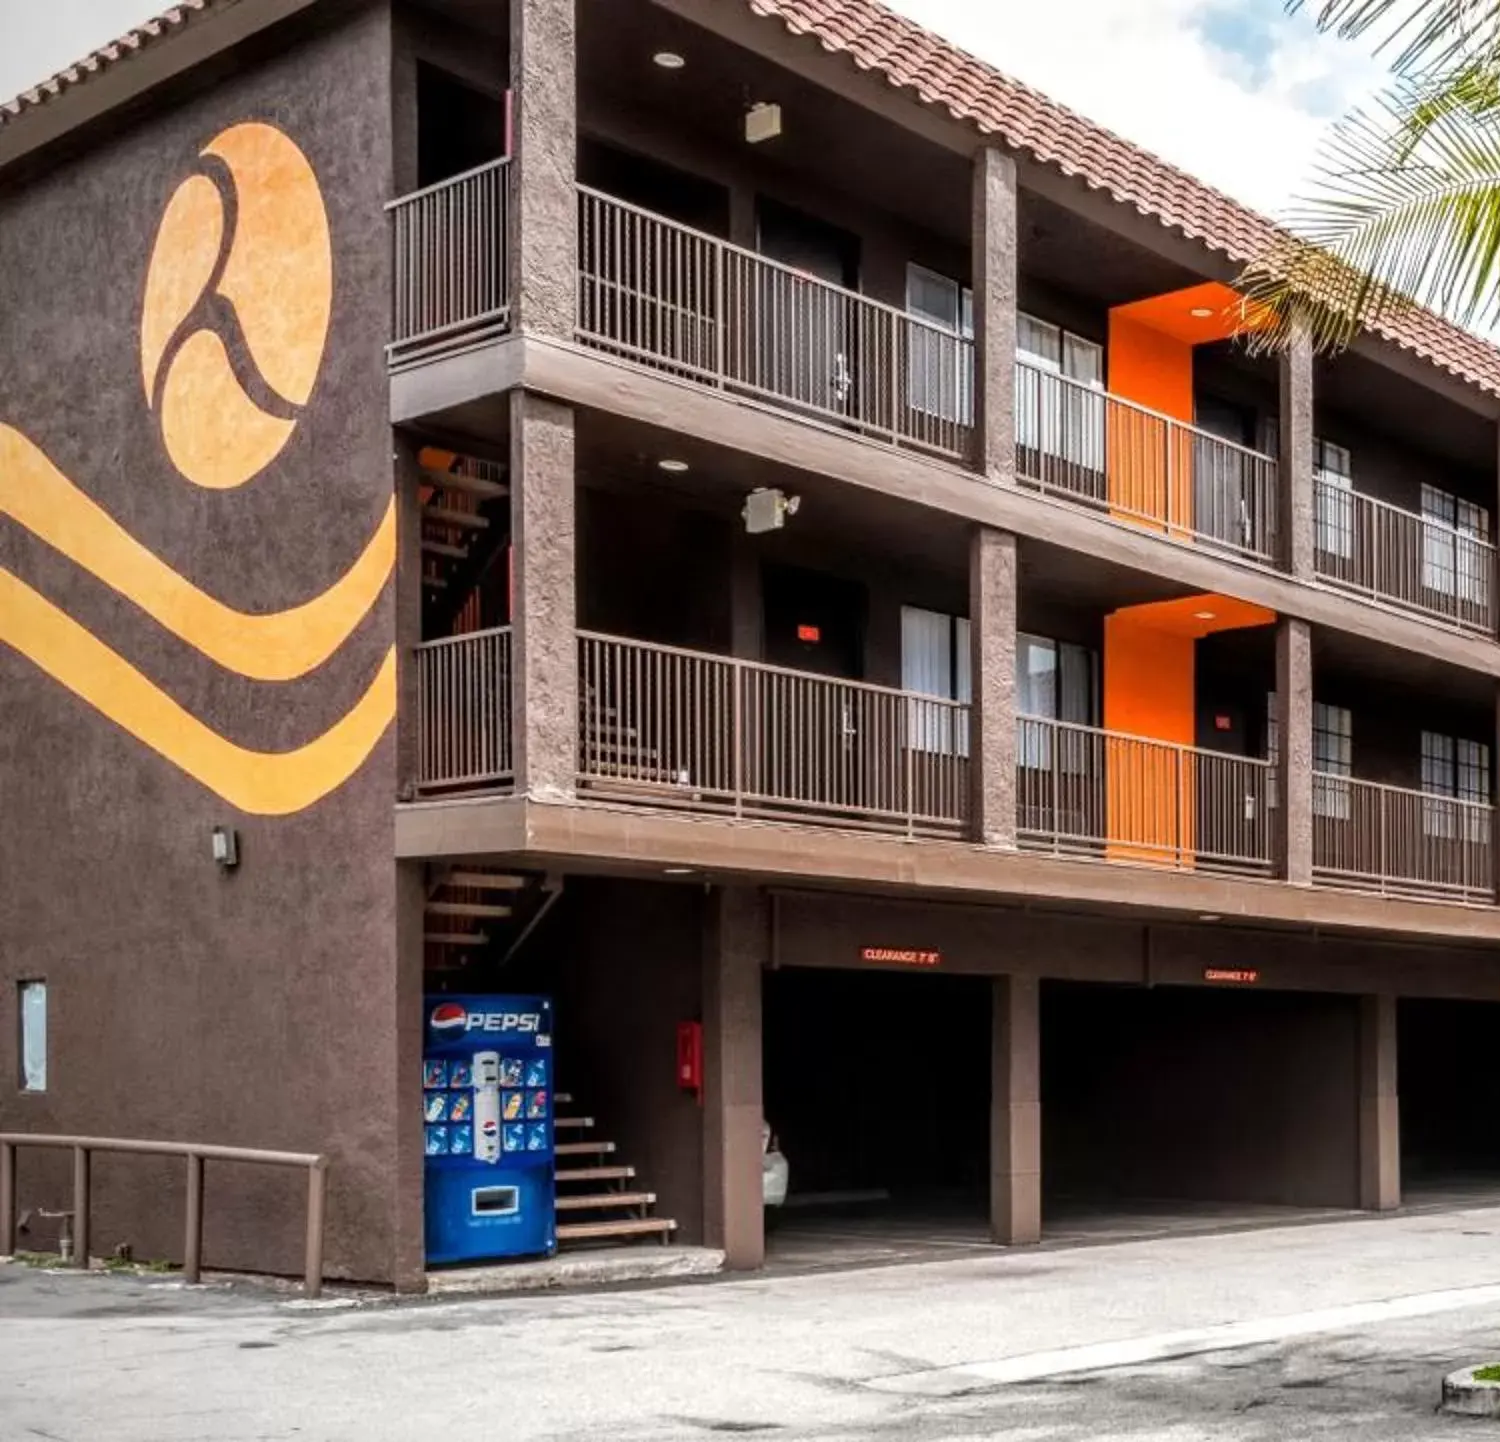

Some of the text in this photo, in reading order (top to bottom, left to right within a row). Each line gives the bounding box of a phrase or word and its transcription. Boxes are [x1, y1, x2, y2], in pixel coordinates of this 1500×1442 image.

[863, 948, 917, 963] CLEARANCE
[1204, 969, 1241, 981] CLEARANCE
[464, 1012, 541, 1032] PEPSI
